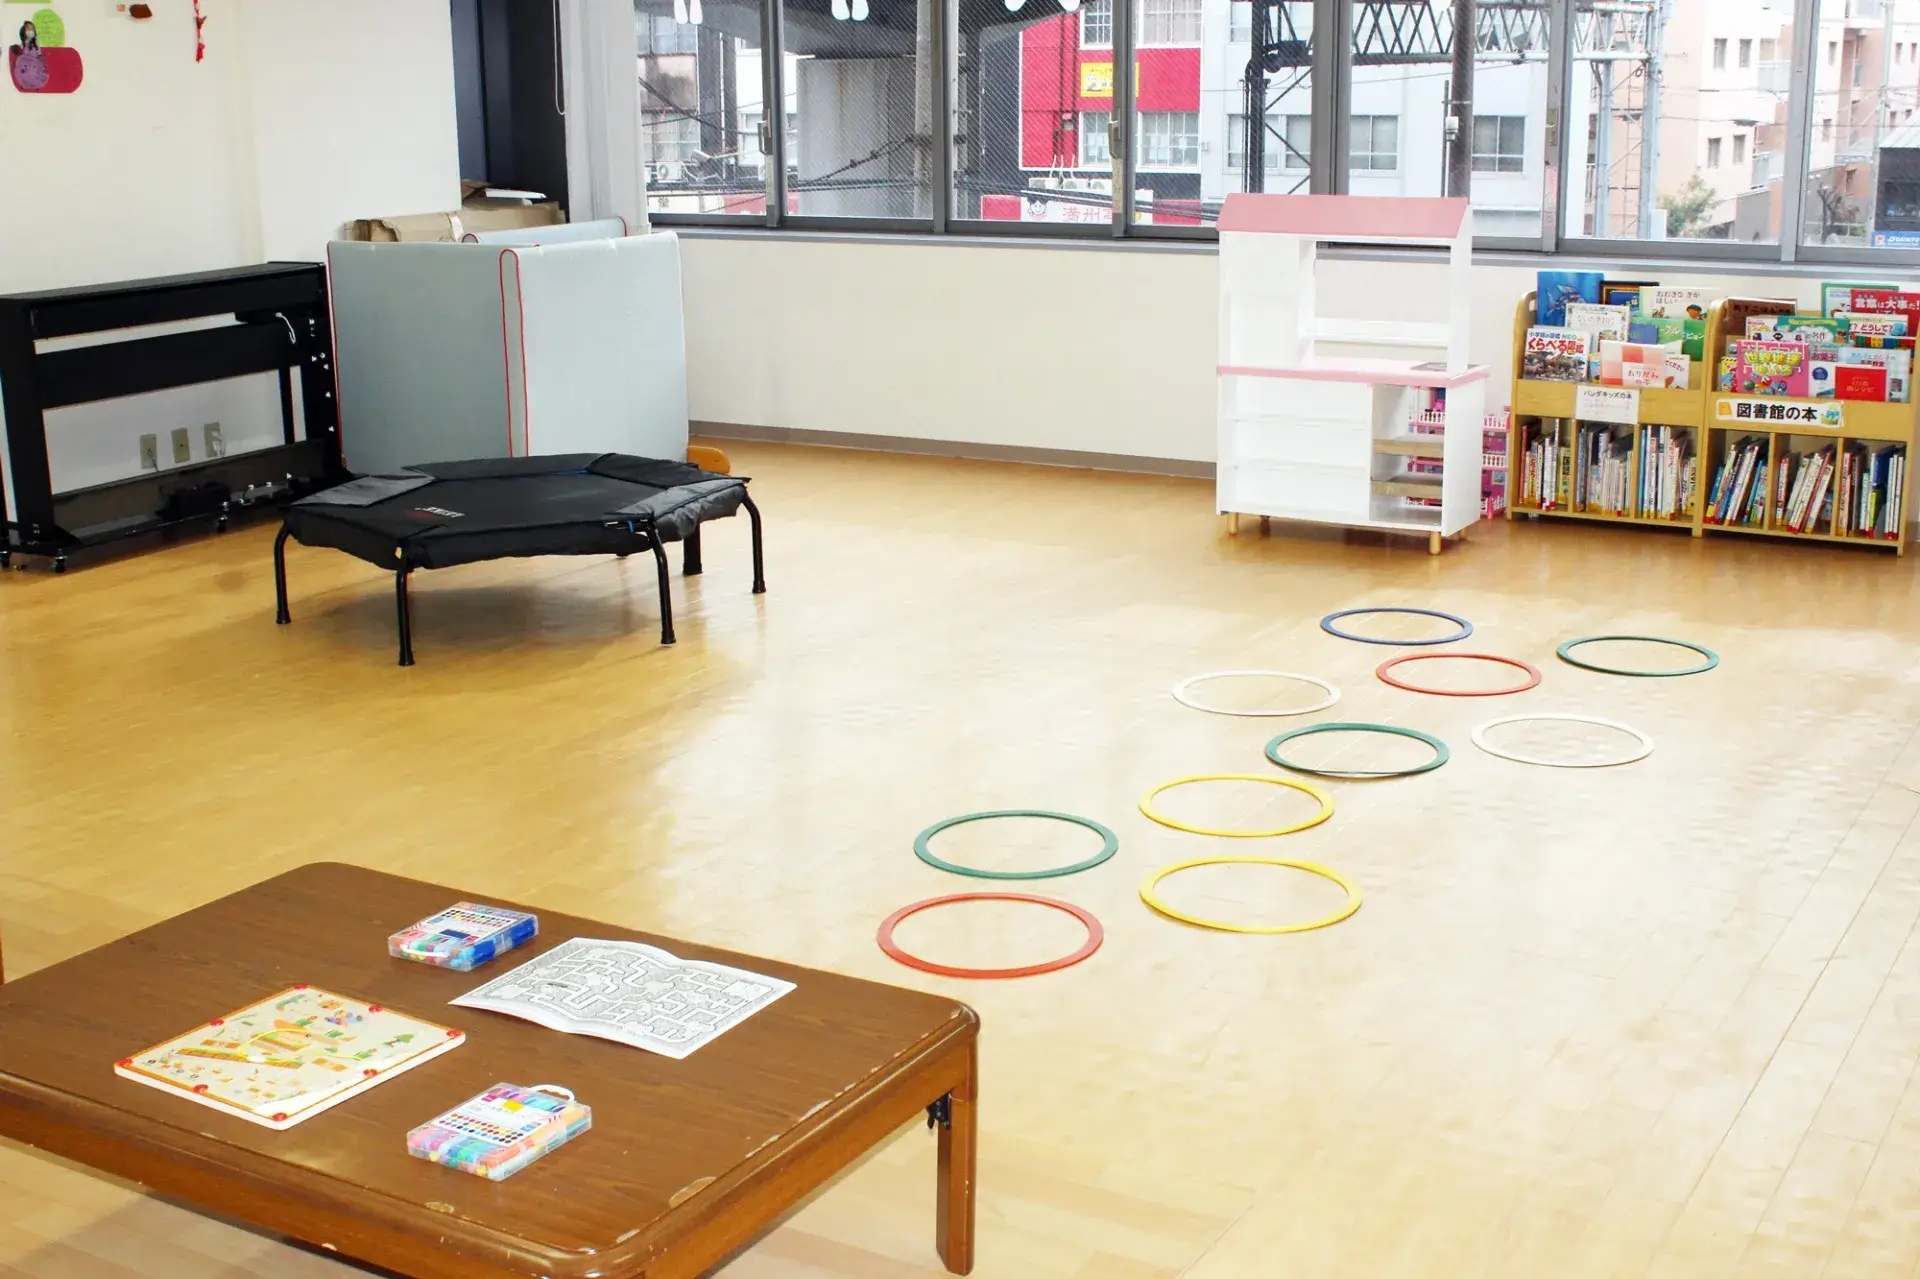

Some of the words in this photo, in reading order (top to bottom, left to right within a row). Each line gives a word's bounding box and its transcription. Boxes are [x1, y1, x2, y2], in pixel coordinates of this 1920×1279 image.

[1528, 337, 1584, 354] くらべる図鑑
[1736, 402, 1818, 422] 図書館の本
